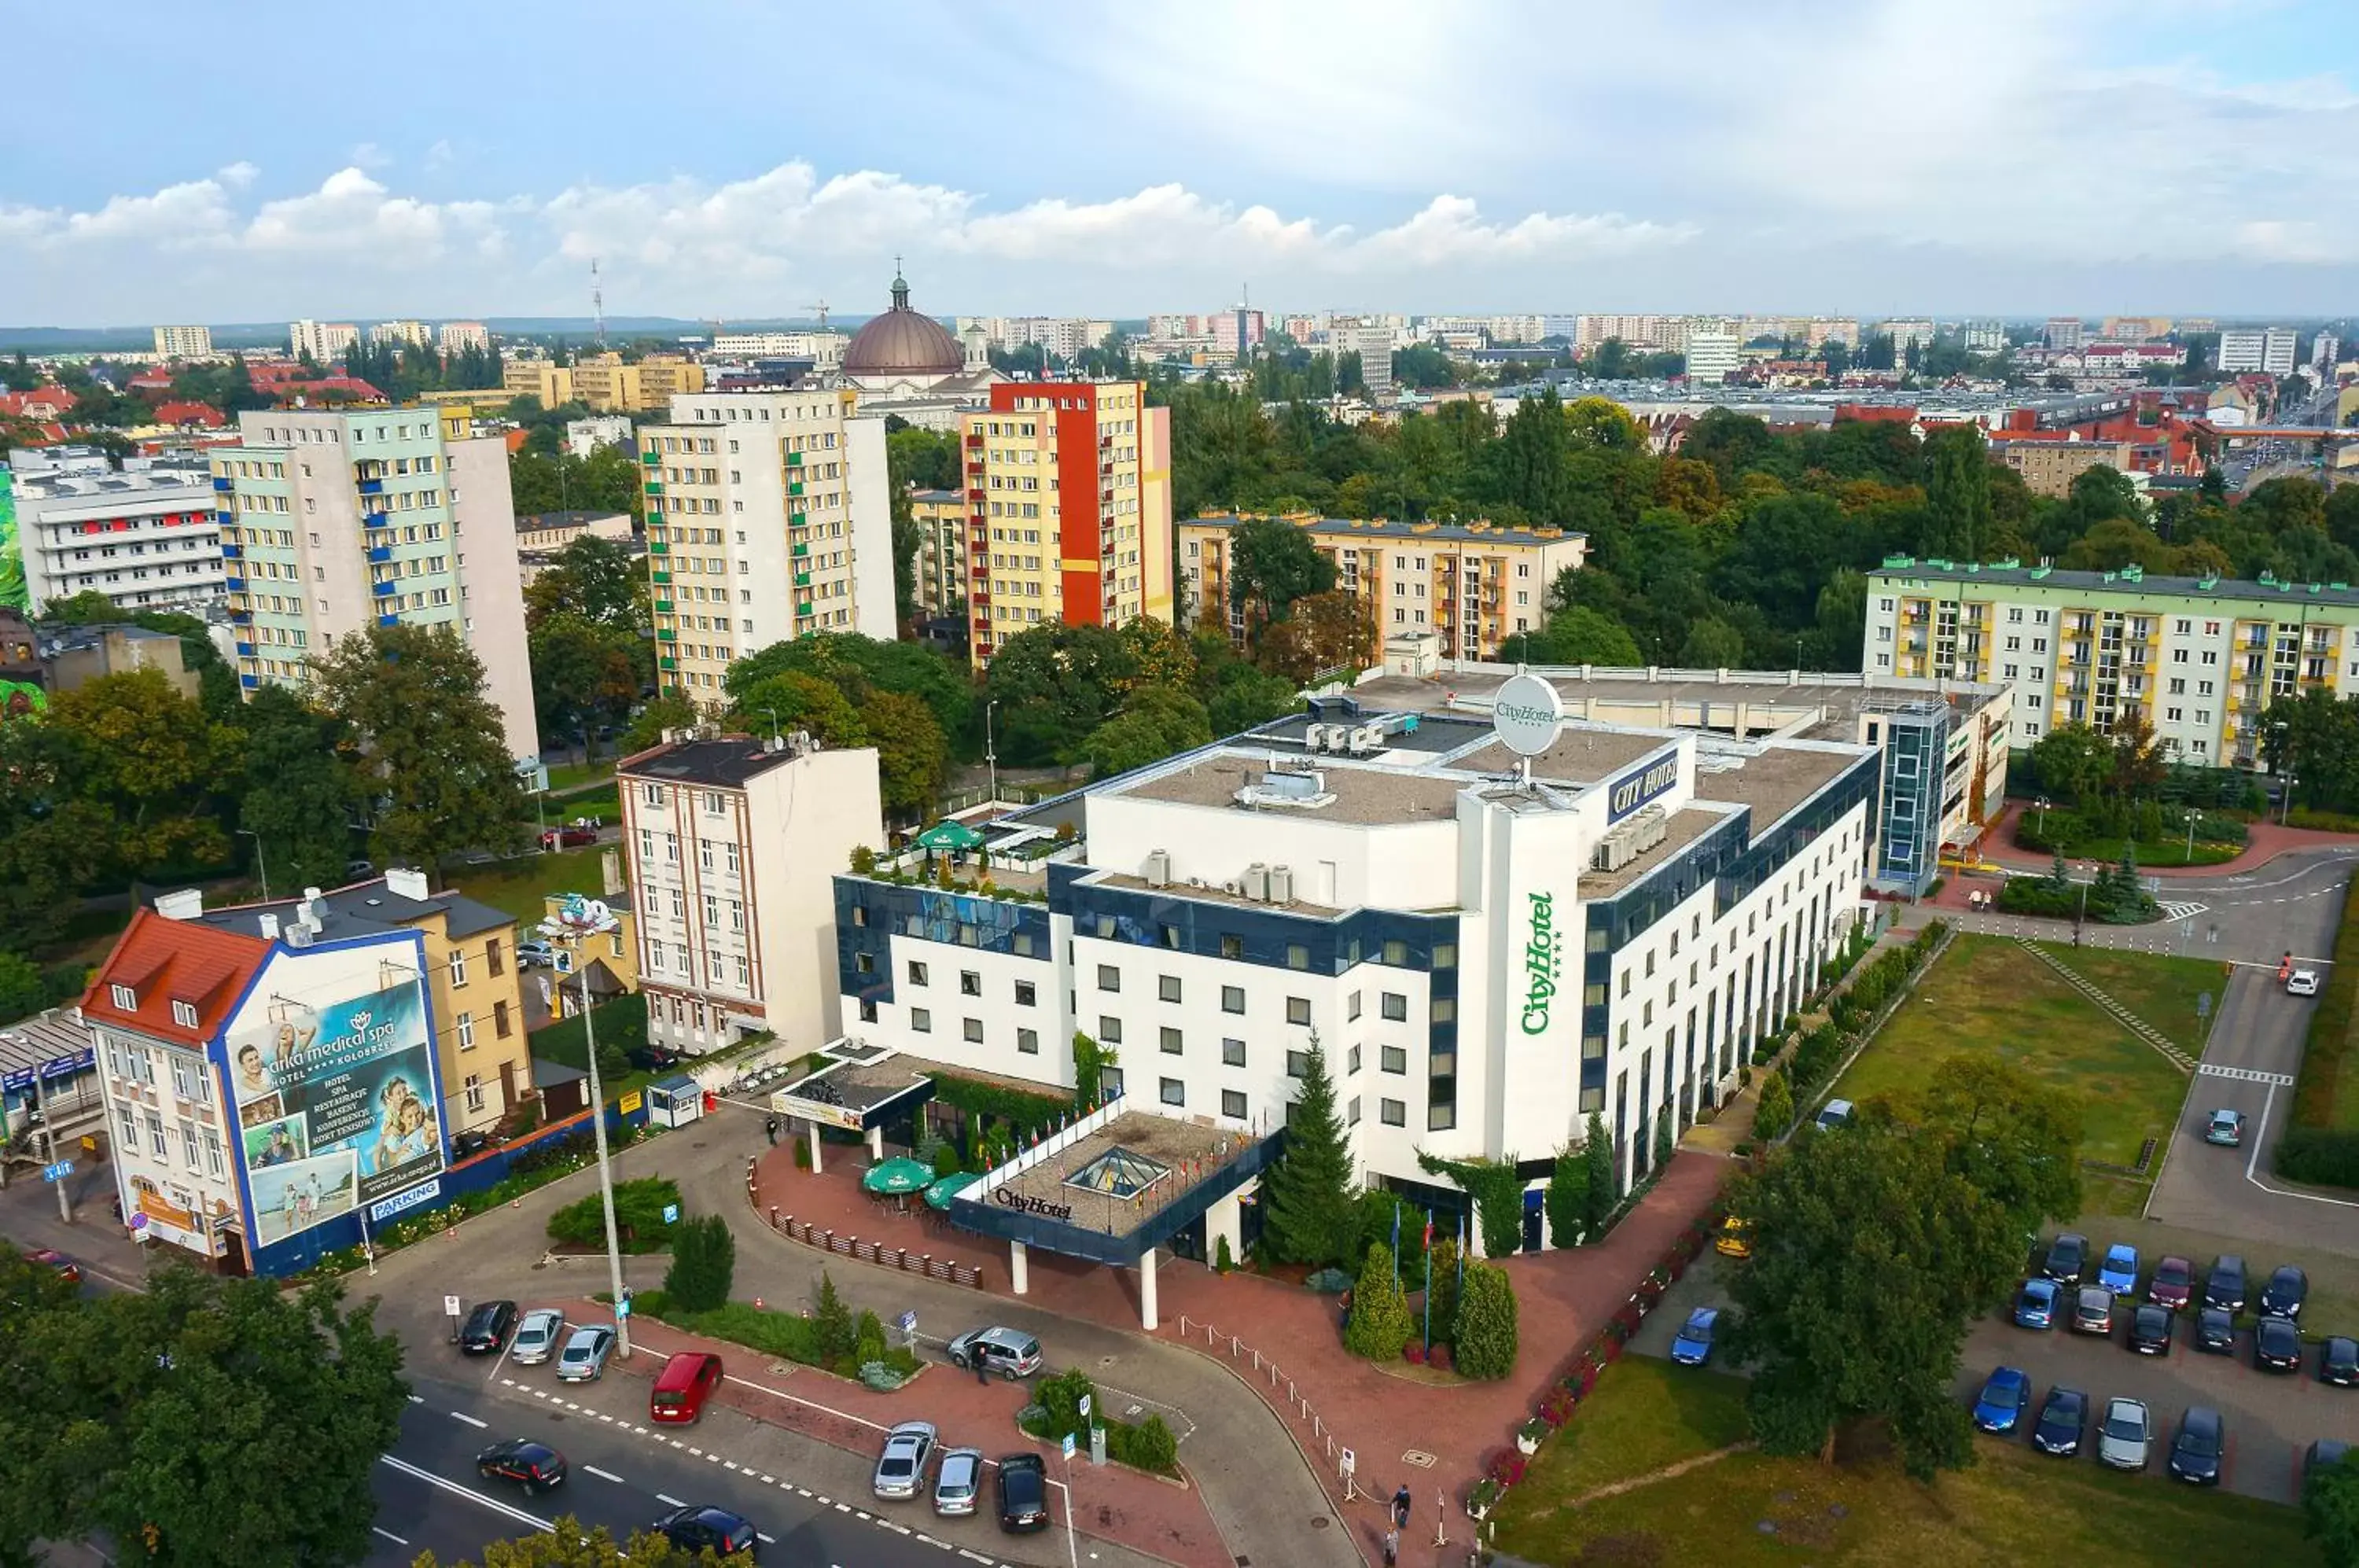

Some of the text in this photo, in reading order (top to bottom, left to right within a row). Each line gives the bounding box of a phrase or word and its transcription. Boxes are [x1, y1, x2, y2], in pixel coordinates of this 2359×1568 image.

[1496, 702, 1555, 723] CityHotel
[1614, 758, 1678, 813] CITY HOTEL
[1522, 892, 1556, 1035] CityHotel
[268, 1022, 396, 1074] arka medical spa
[270, 1070, 306, 1087] HOTEL
[374, 1182, 436, 1216] PARKING
[995, 1188, 1072, 1219] CityHotel
